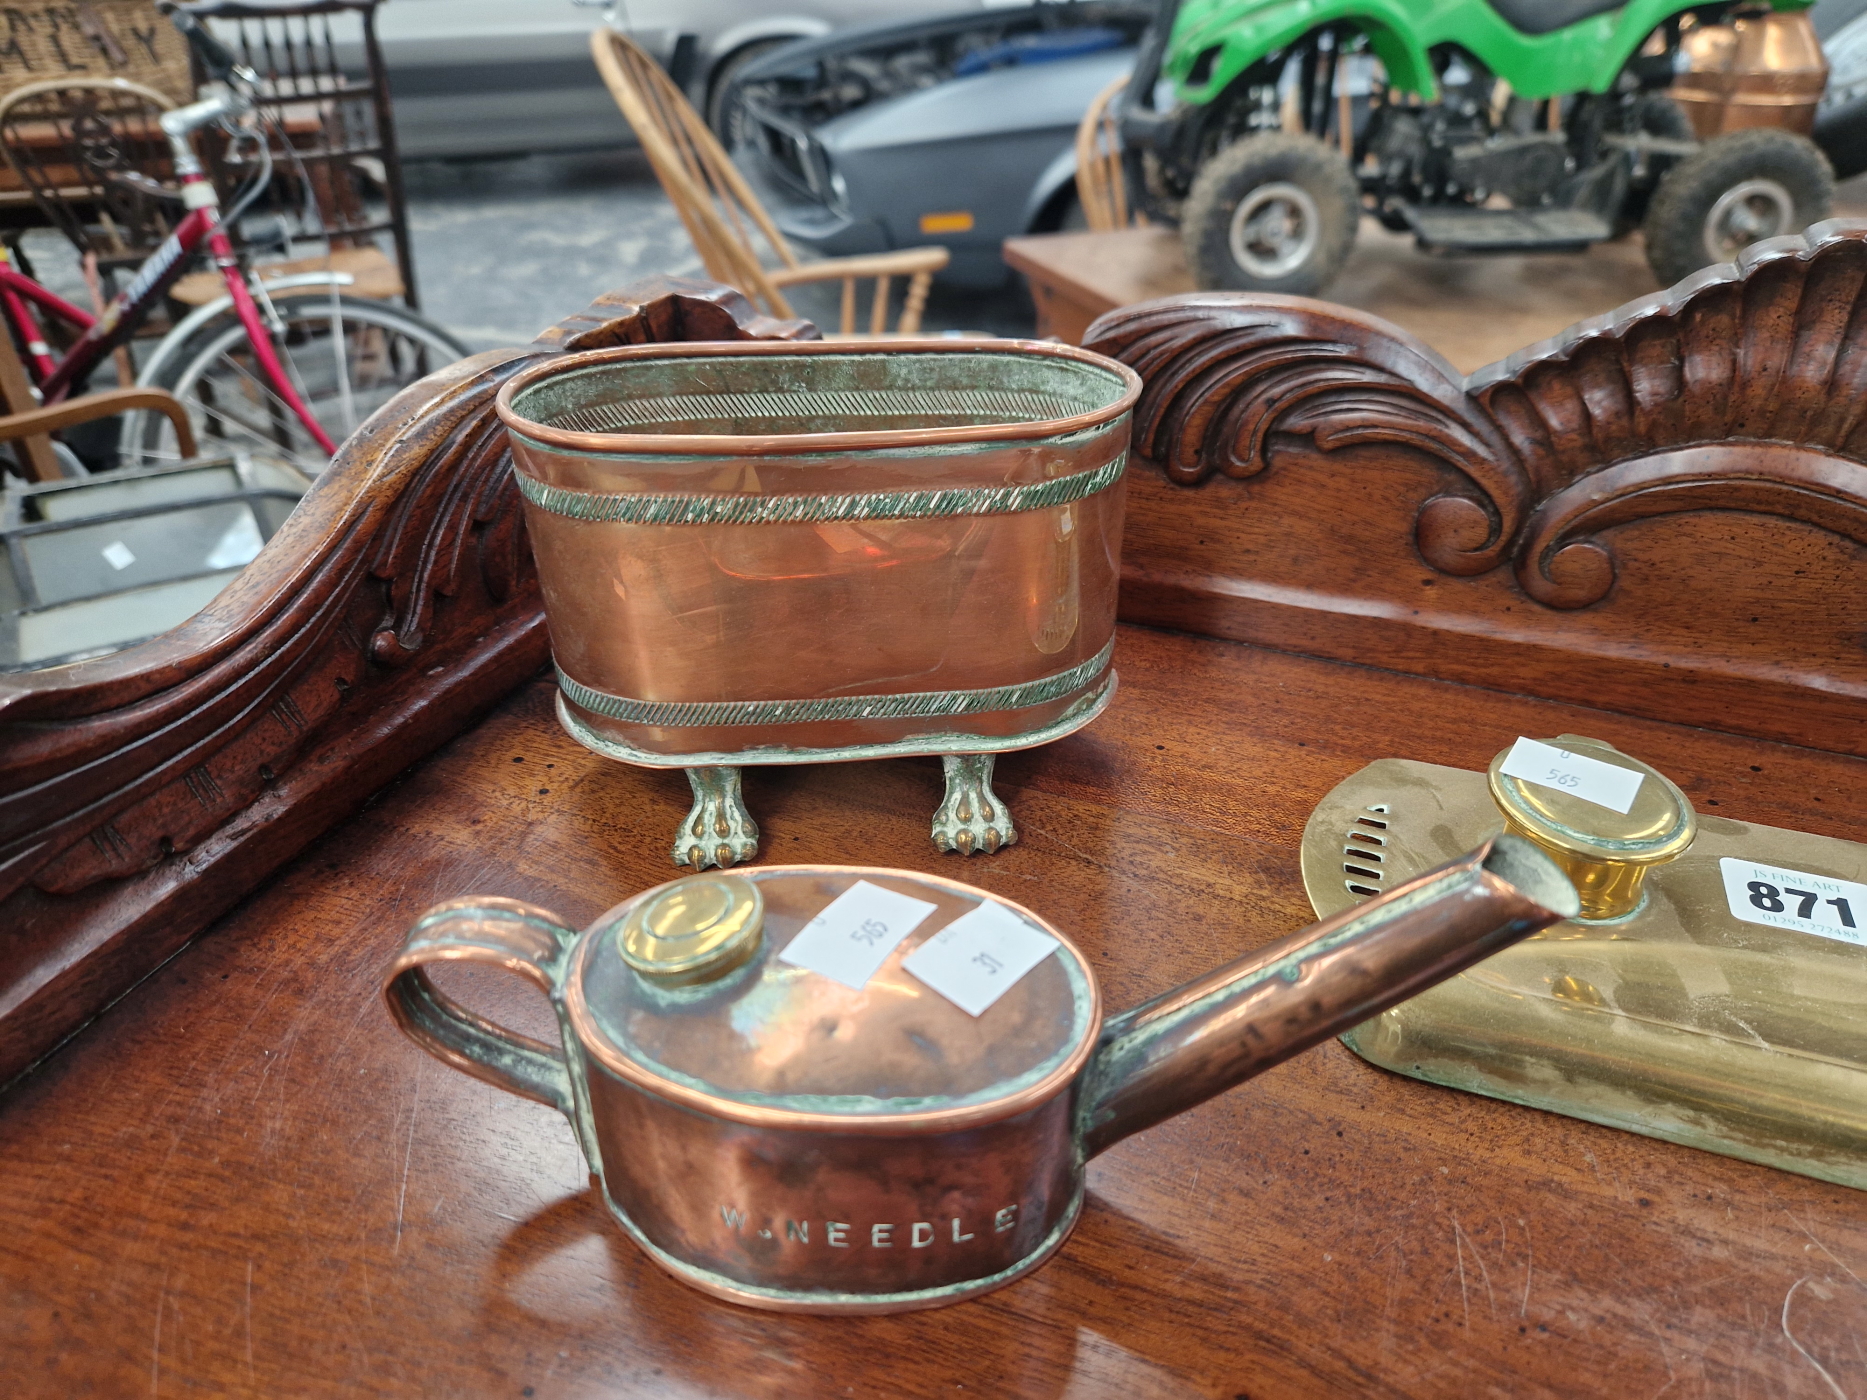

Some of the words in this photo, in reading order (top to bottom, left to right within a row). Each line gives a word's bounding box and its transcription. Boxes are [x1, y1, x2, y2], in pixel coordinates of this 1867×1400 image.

[1545, 768, 1582, 788] 565
[1753, 869, 1767, 879] JS
[1772, 872, 1807, 887] FINE
[1811, 881, 1843, 893] ART
[1746, 880, 1857, 929] 871
[849, 918, 889, 947] 565
[1762, 913, 1804, 928] 01295
[1810, 922, 1860, 940] 272488
